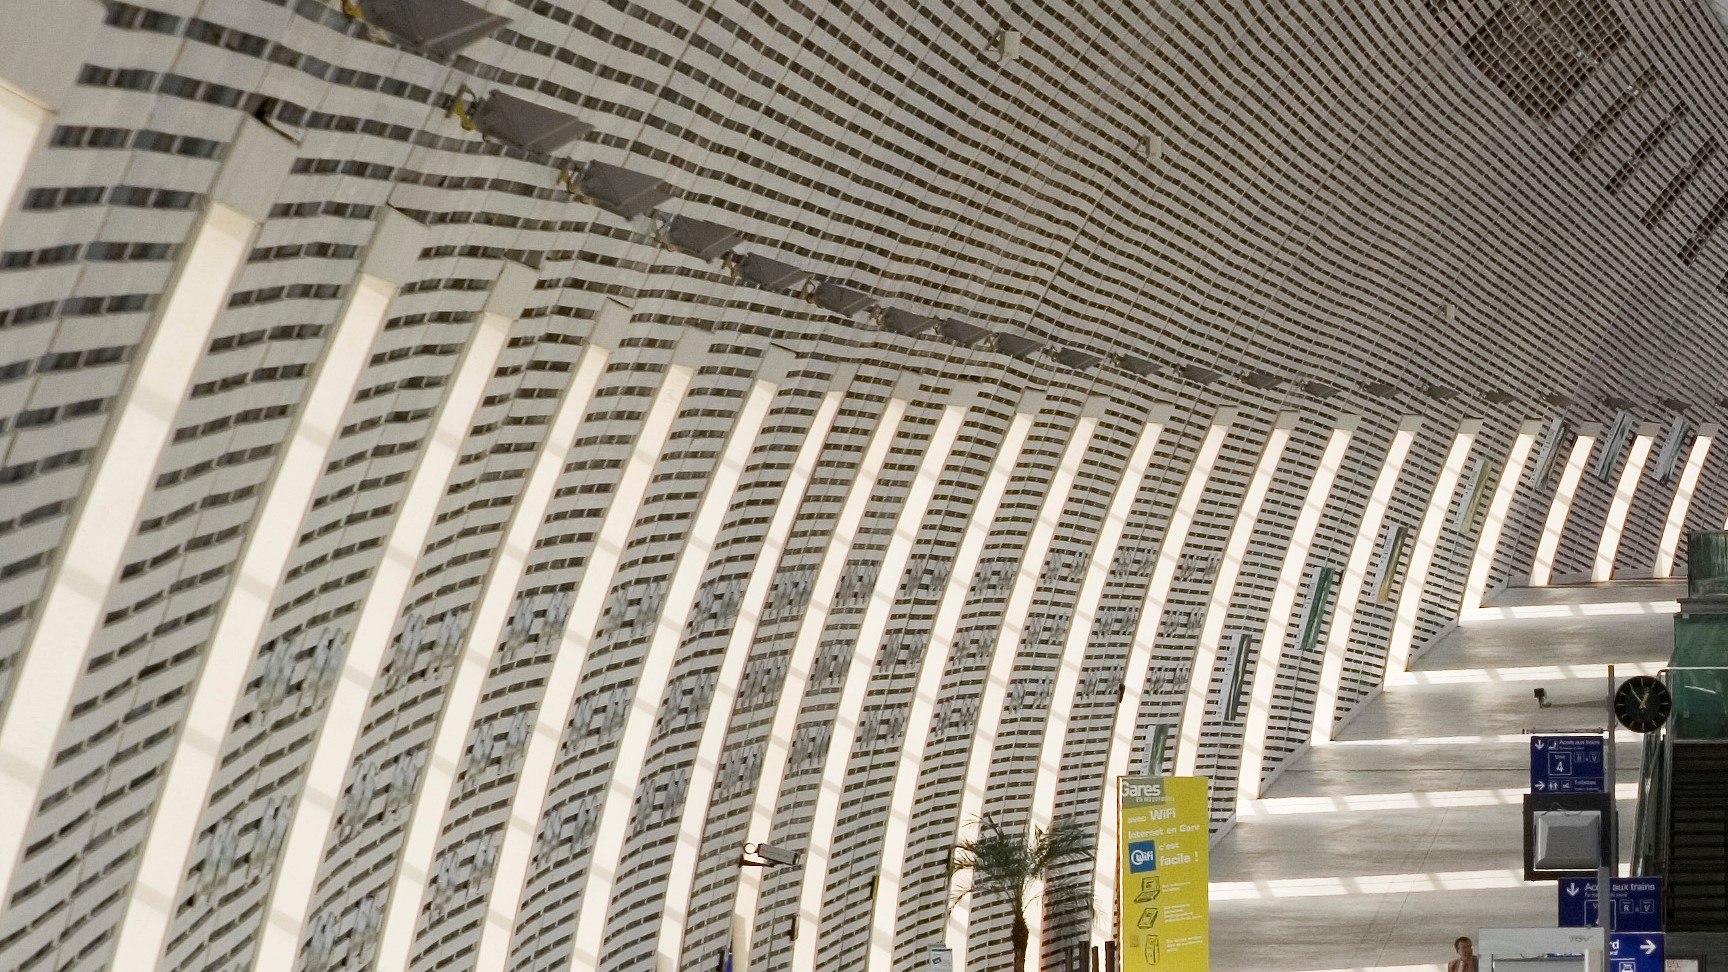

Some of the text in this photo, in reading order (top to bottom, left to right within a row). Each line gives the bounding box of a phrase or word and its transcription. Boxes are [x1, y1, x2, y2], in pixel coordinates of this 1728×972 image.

[1556, 761, 1564, 772] 4
[1149, 808, 1177, 820] WiFi
[1128, 828, 1163, 839] Internet
[1179, 824, 1200, 832] Gare
[1160, 853, 1191, 866] facile
[1630, 882, 1655, 891] trains
